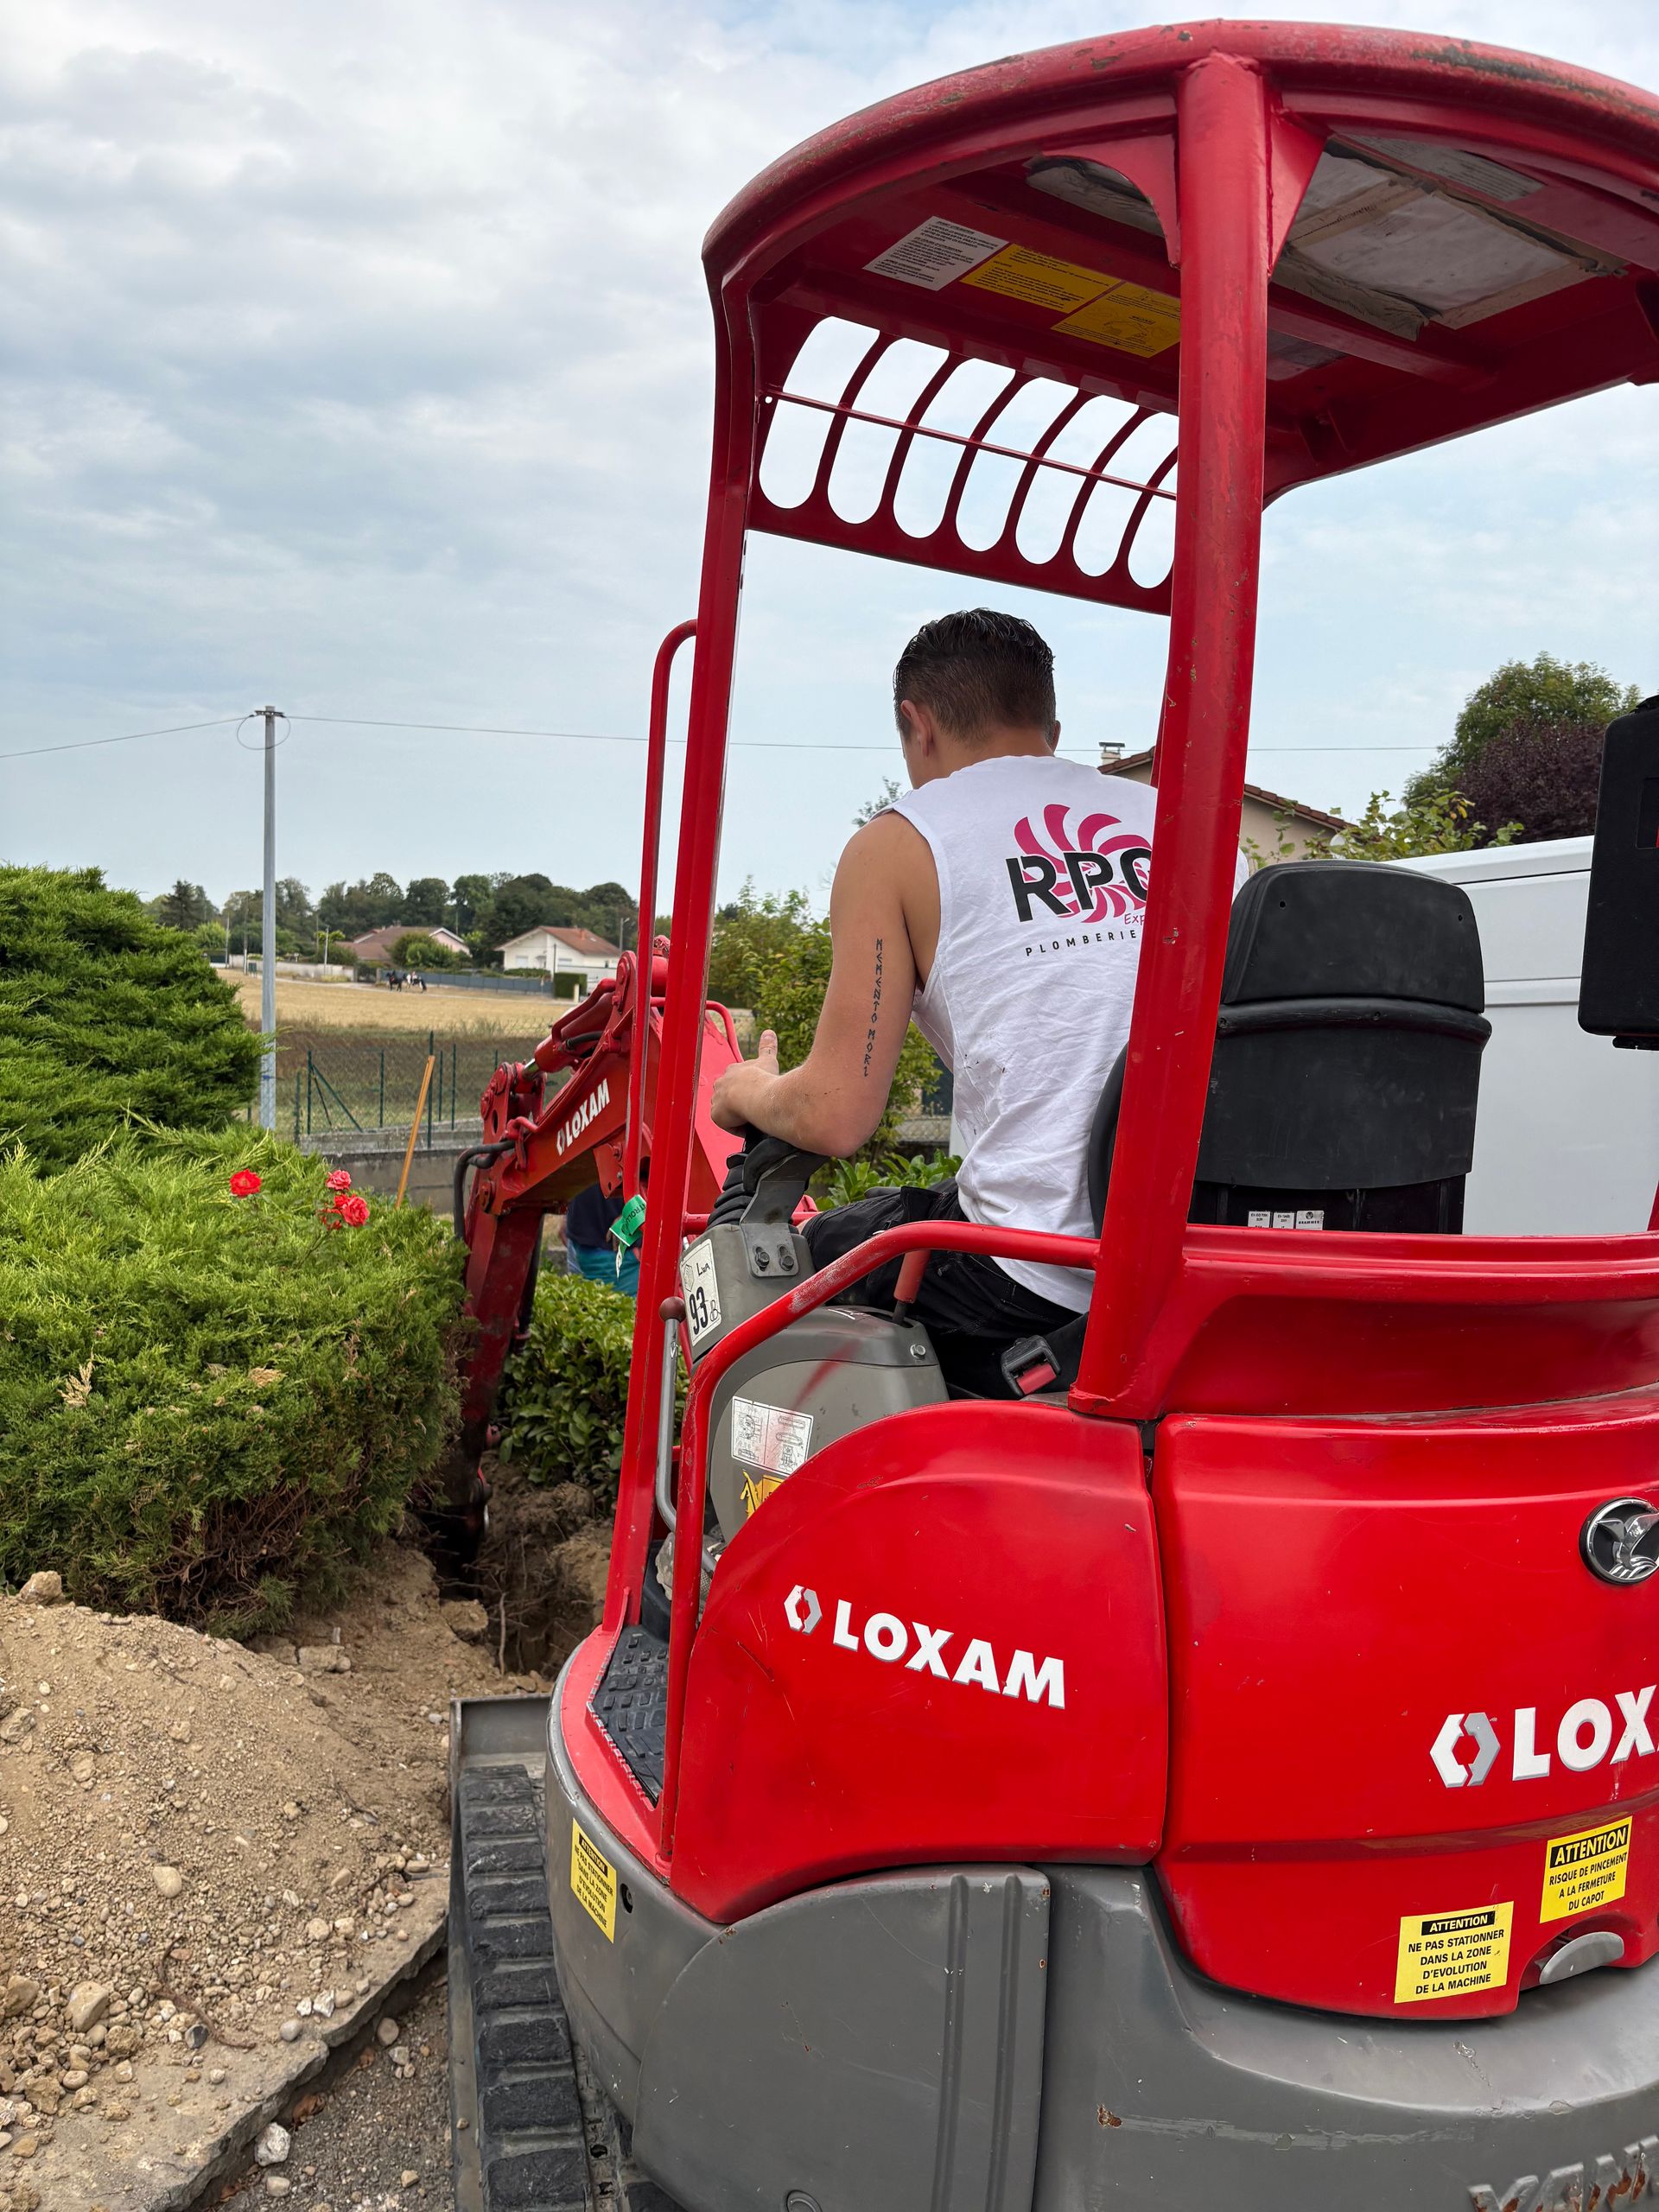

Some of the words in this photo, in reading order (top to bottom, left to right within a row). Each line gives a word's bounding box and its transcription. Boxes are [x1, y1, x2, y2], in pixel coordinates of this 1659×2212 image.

[1026, 929, 1137, 957] PLOMBERIE
[871, 938, 883, 1024] MEMENTO
[565, 1077, 610, 1147] LOXAM
[689, 1286, 709, 1335] 93
[833, 1599, 1065, 1710] LOXAM
[1512, 1683, 1659, 1782] LOX
[581, 1839, 605, 1872] ATTENTION
[1554, 1827, 1627, 1866] ATTENTION
[578, 1862, 588, 1881] DANS
[589, 1874, 595, 1889] LA
[595, 1883, 607, 1903] ZONE
[588, 1862, 613, 1897] STATIONNER
[1549, 1869, 1578, 1885] RISQUE
[1579, 1866, 1589, 1878] DE
[1590, 1852, 1628, 1874] PINCEMENT
[1559, 1888, 1565, 1899] A
[1567, 1885, 1576, 1897] LA
[1578, 1871, 1617, 1893] FERMETURE
[579, 1875, 606, 1914] D'EVOLUTION
[1568, 1899, 1580, 1911] DU
[1581, 1891, 1605, 1907] CAPOT
[588, 1898, 607, 1929] MACHINE
[1429, 1914, 1488, 1933] ATTENTION
[1408, 1942, 1422, 1953] NE
[1425, 1940, 1444, 1951] PAS
[1447, 1929, 1504, 1948] STATIONNER
[1421, 1953, 1448, 1966] DANS
[1452, 1951, 1464, 1961] LA
[1466, 1946, 1491, 1959] ZONE
[1415, 1985, 1429, 1994] DE
[1432, 1982, 1445, 1993] LA
[1447, 1974, 1491, 1990] MACHINE
[1422, 1961, 1487, 1980] D'EVOLUTION
